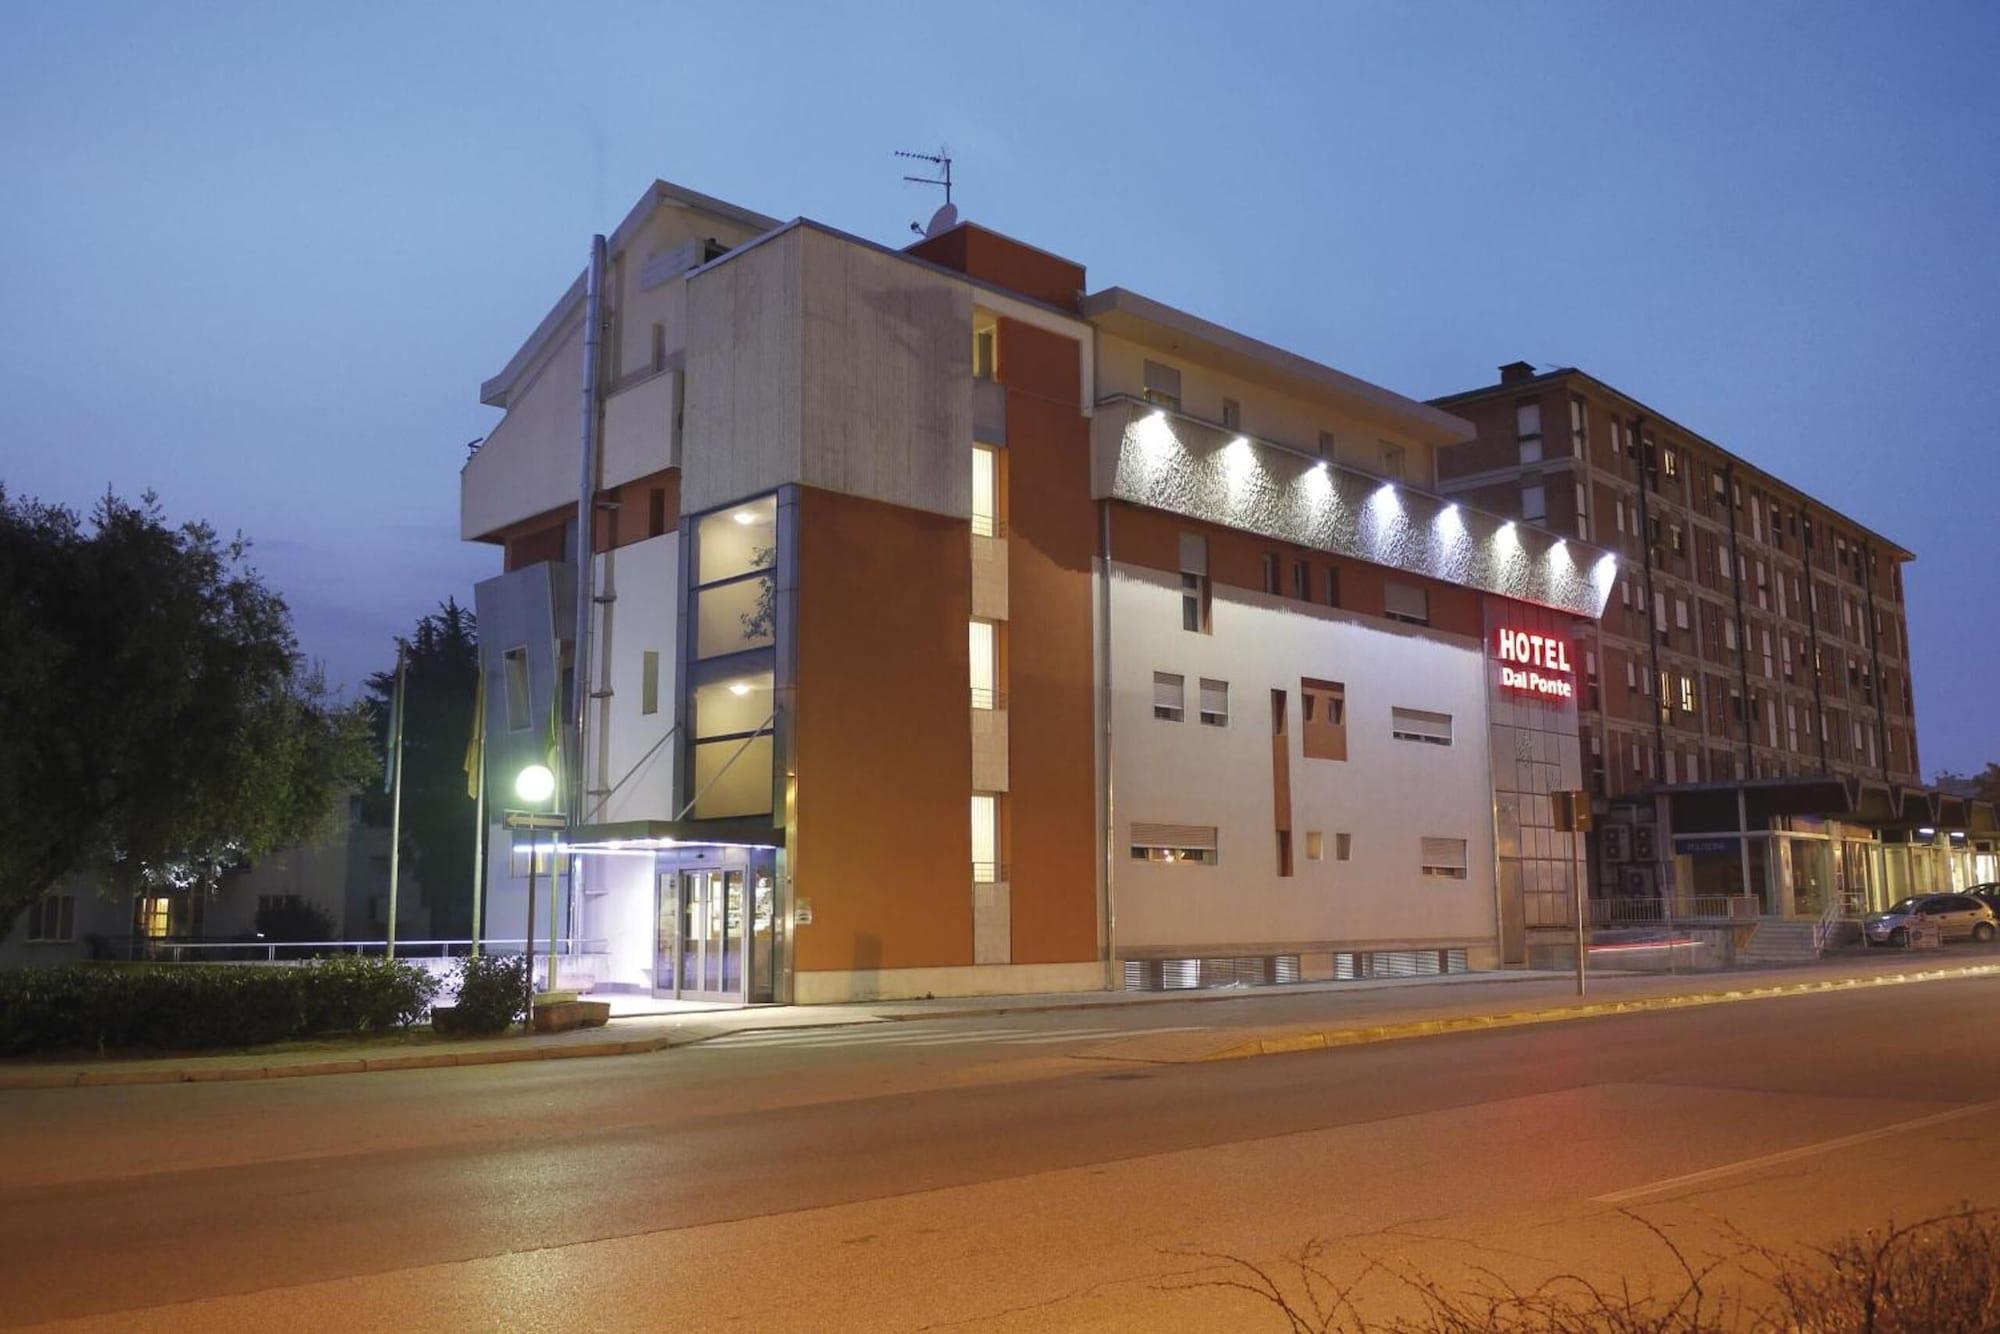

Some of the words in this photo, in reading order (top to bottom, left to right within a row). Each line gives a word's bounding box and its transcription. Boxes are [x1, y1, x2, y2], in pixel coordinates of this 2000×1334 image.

[1500, 629, 1570, 672] HOTEL
[1502, 667, 1527, 689] Dal
[1530, 673, 1571, 697] Ponte
